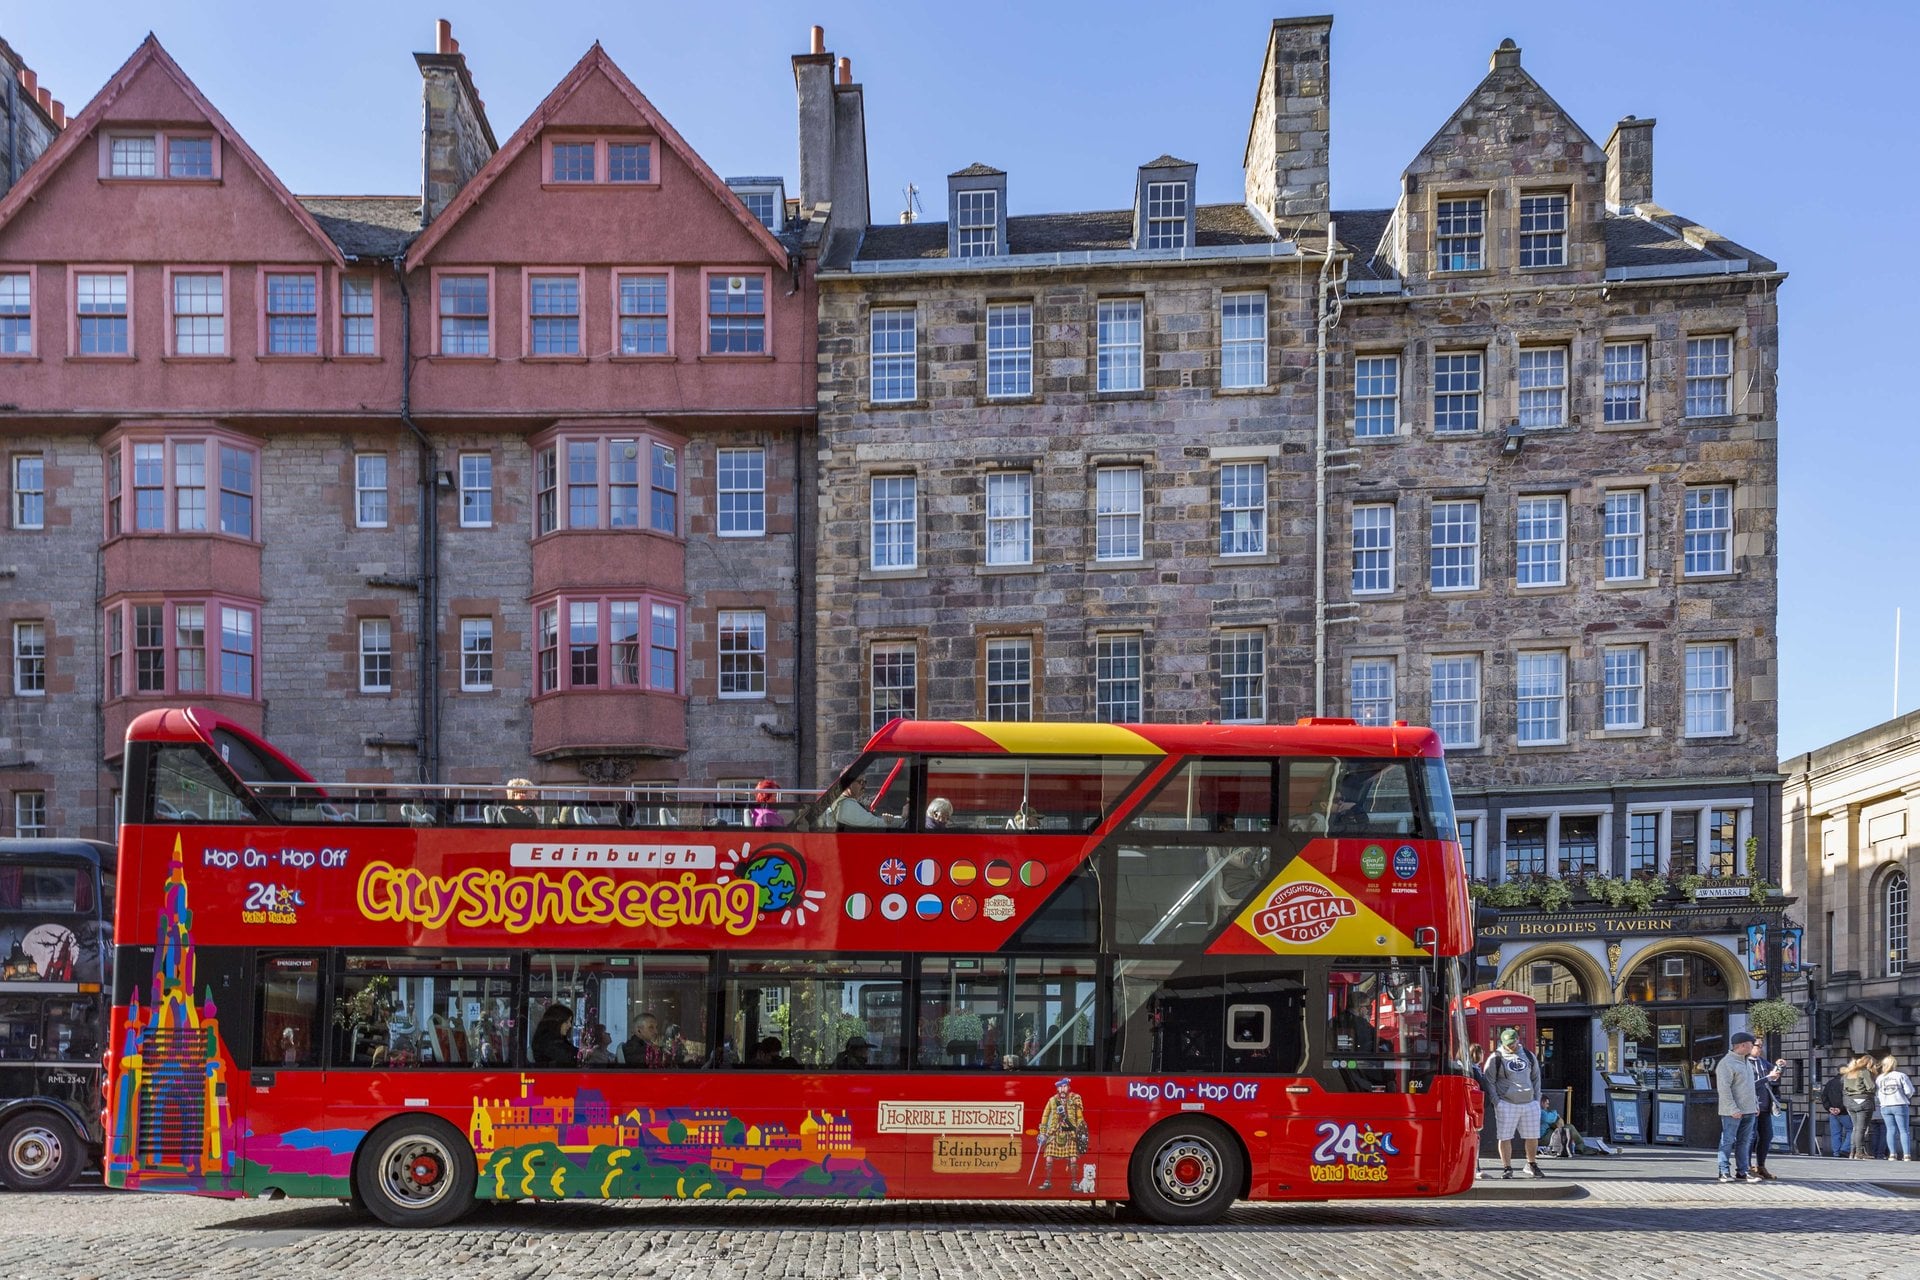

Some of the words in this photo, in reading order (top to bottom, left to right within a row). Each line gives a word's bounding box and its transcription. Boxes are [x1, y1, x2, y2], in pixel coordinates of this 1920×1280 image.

[203, 848, 239, 869] Hop
[244, 848, 267, 868] On
[280, 848, 316, 869] Hop
[320, 848, 348, 868] Off
[530, 847, 697, 866] Edinburgh
[1697, 888, 1749, 897] AWNMARKET
[1706, 880, 1732, 888] ROYAL
[1735, 879, 1753, 887] MILE
[245, 882, 277, 911] 24
[357, 861, 760, 936] CitySightseeing
[1274, 885, 1328, 905] CITYSIGHTSEEING
[242, 911, 267, 924] Valid
[268, 911, 297, 924] Ticket
[1263, 900, 1351, 931] OFFICIAL
[1291, 922, 1330, 940] TOUR
[1519, 922, 1597, 935] BRODIE'S
[1604, 919, 1673, 931] TAVERN
[48, 1076, 65, 1084] RML
[67, 1076, 86, 1084] 2343
[1409, 1080, 1423, 1088] 226
[1128, 1082, 1159, 1101] Hop
[1164, 1082, 1185, 1100] On
[1198, 1082, 1229, 1101] Hop
[1233, 1082, 1258, 1100] Off
[887, 1109, 946, 1126] HORRIBLE
[951, 1109, 1015, 1126] HISTORIES
[938, 1141, 1018, 1161] Edinburgh
[1314, 1122, 1360, 1162] 24
[1356, 1151, 1384, 1163] hrs.
[940, 1159, 947, 1167] by
[949, 1158, 972, 1169] Terry
[974, 1158, 1000, 1169] Deary
[1311, 1164, 1344, 1181] Valid
[1347, 1163, 1388, 1181] Ticket
